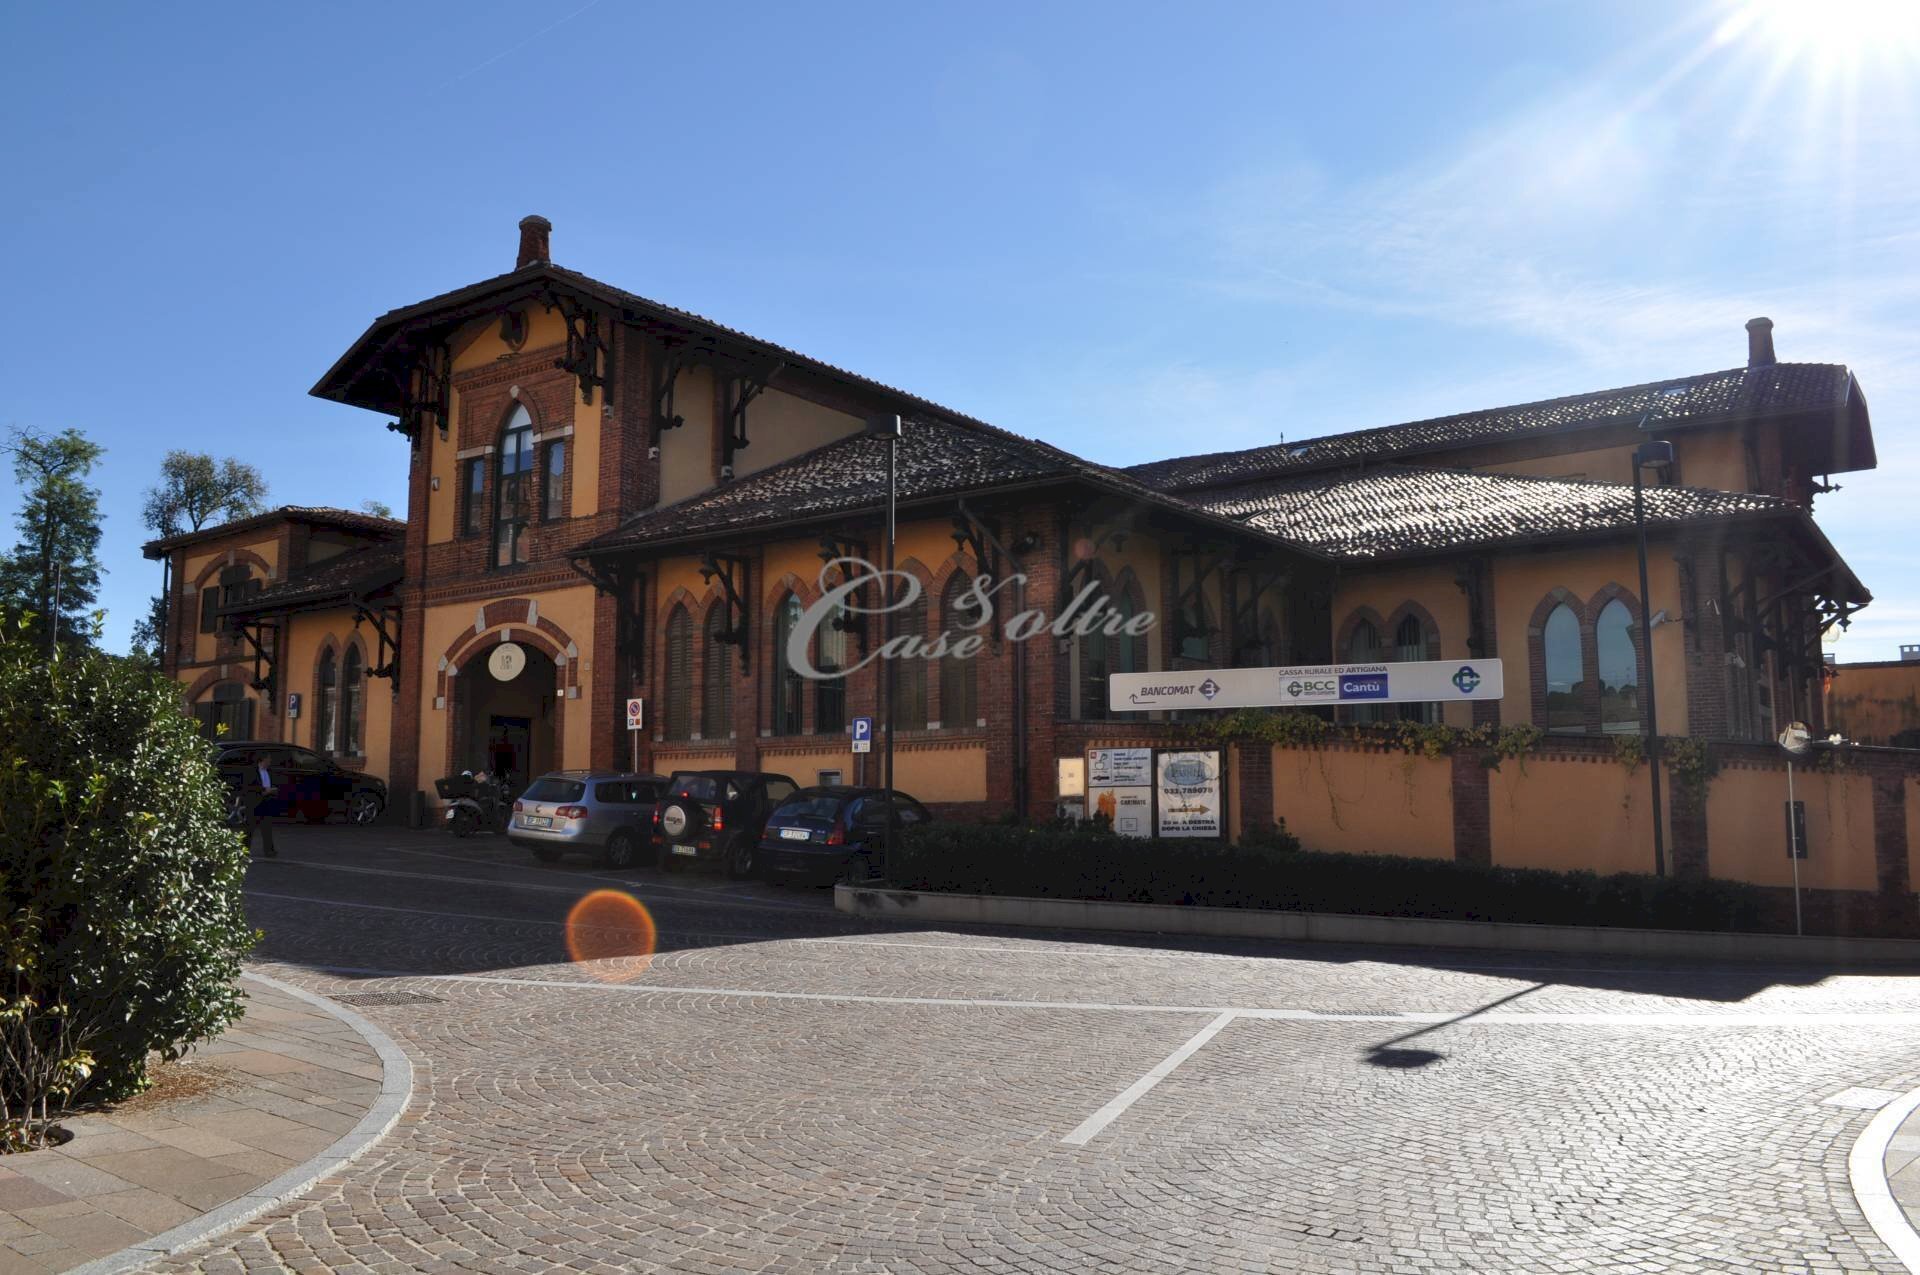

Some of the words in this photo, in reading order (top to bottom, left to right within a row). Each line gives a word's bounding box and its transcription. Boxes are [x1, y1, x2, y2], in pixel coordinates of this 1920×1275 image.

[1346, 665, 1388, 673] ARTIGIANA
[1140, 685, 1196, 697] BANCOMAT
[1303, 681, 1336, 691] BCC
[1343, 681, 1380, 692] Cantù
[855, 720, 868, 739] P
